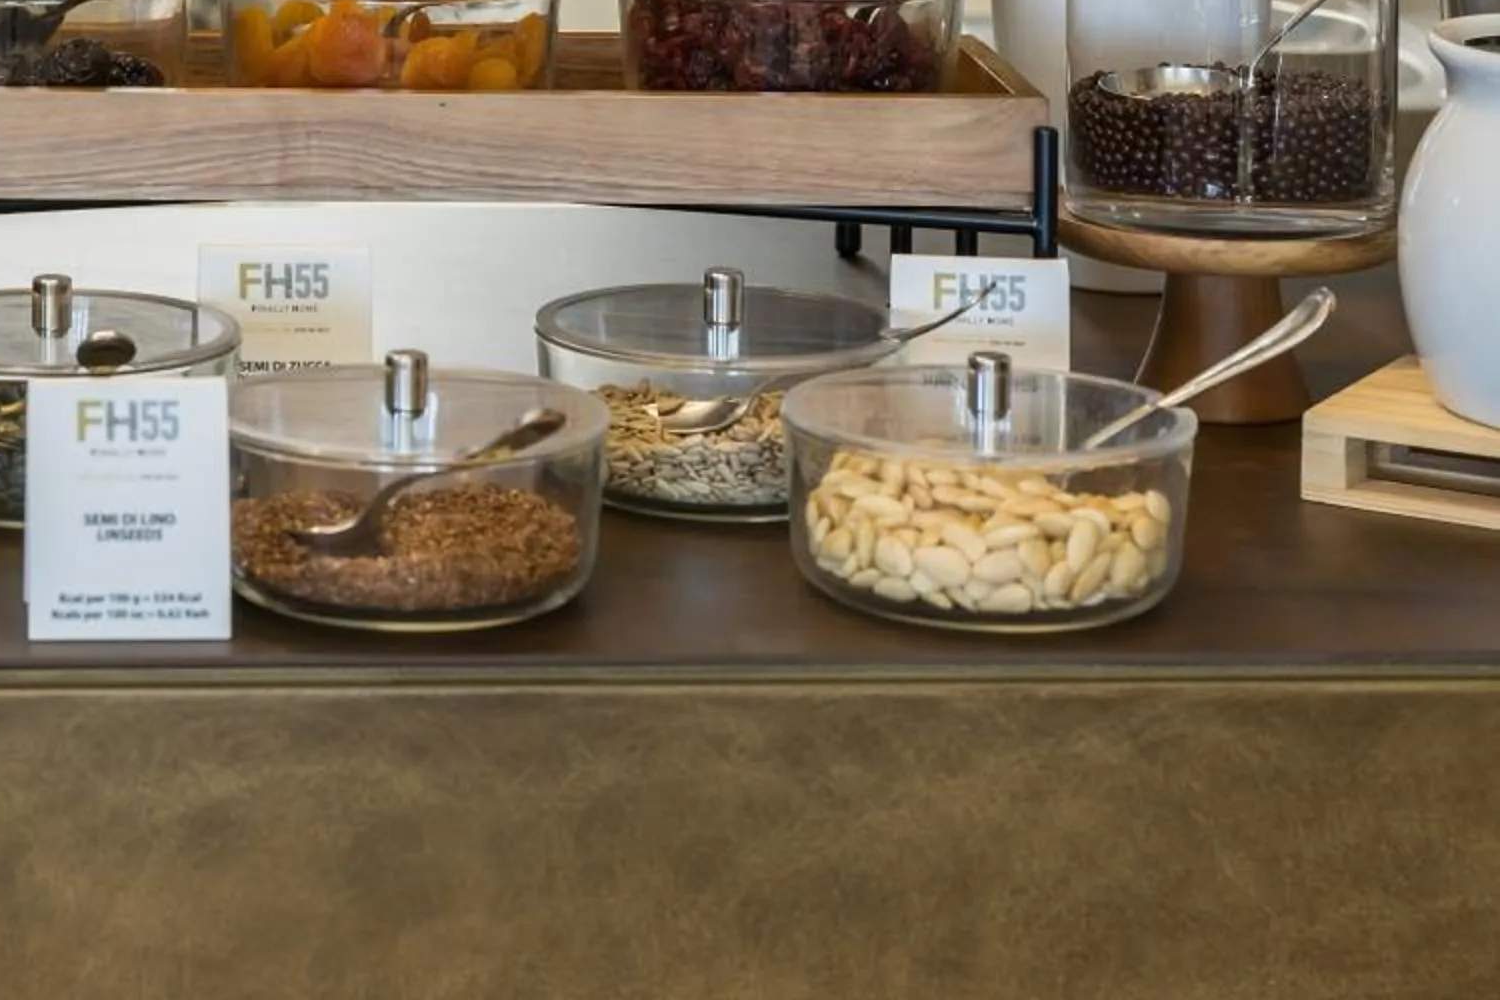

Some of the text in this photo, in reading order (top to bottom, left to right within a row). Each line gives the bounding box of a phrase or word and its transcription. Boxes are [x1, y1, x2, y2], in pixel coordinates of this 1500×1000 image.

[238, 262, 330, 300] FH55
[933, 271, 1026, 312] FH55
[76, 400, 180, 442] FH55
[83, 512, 119, 527] SEMI
[121, 512, 138, 527] DI
